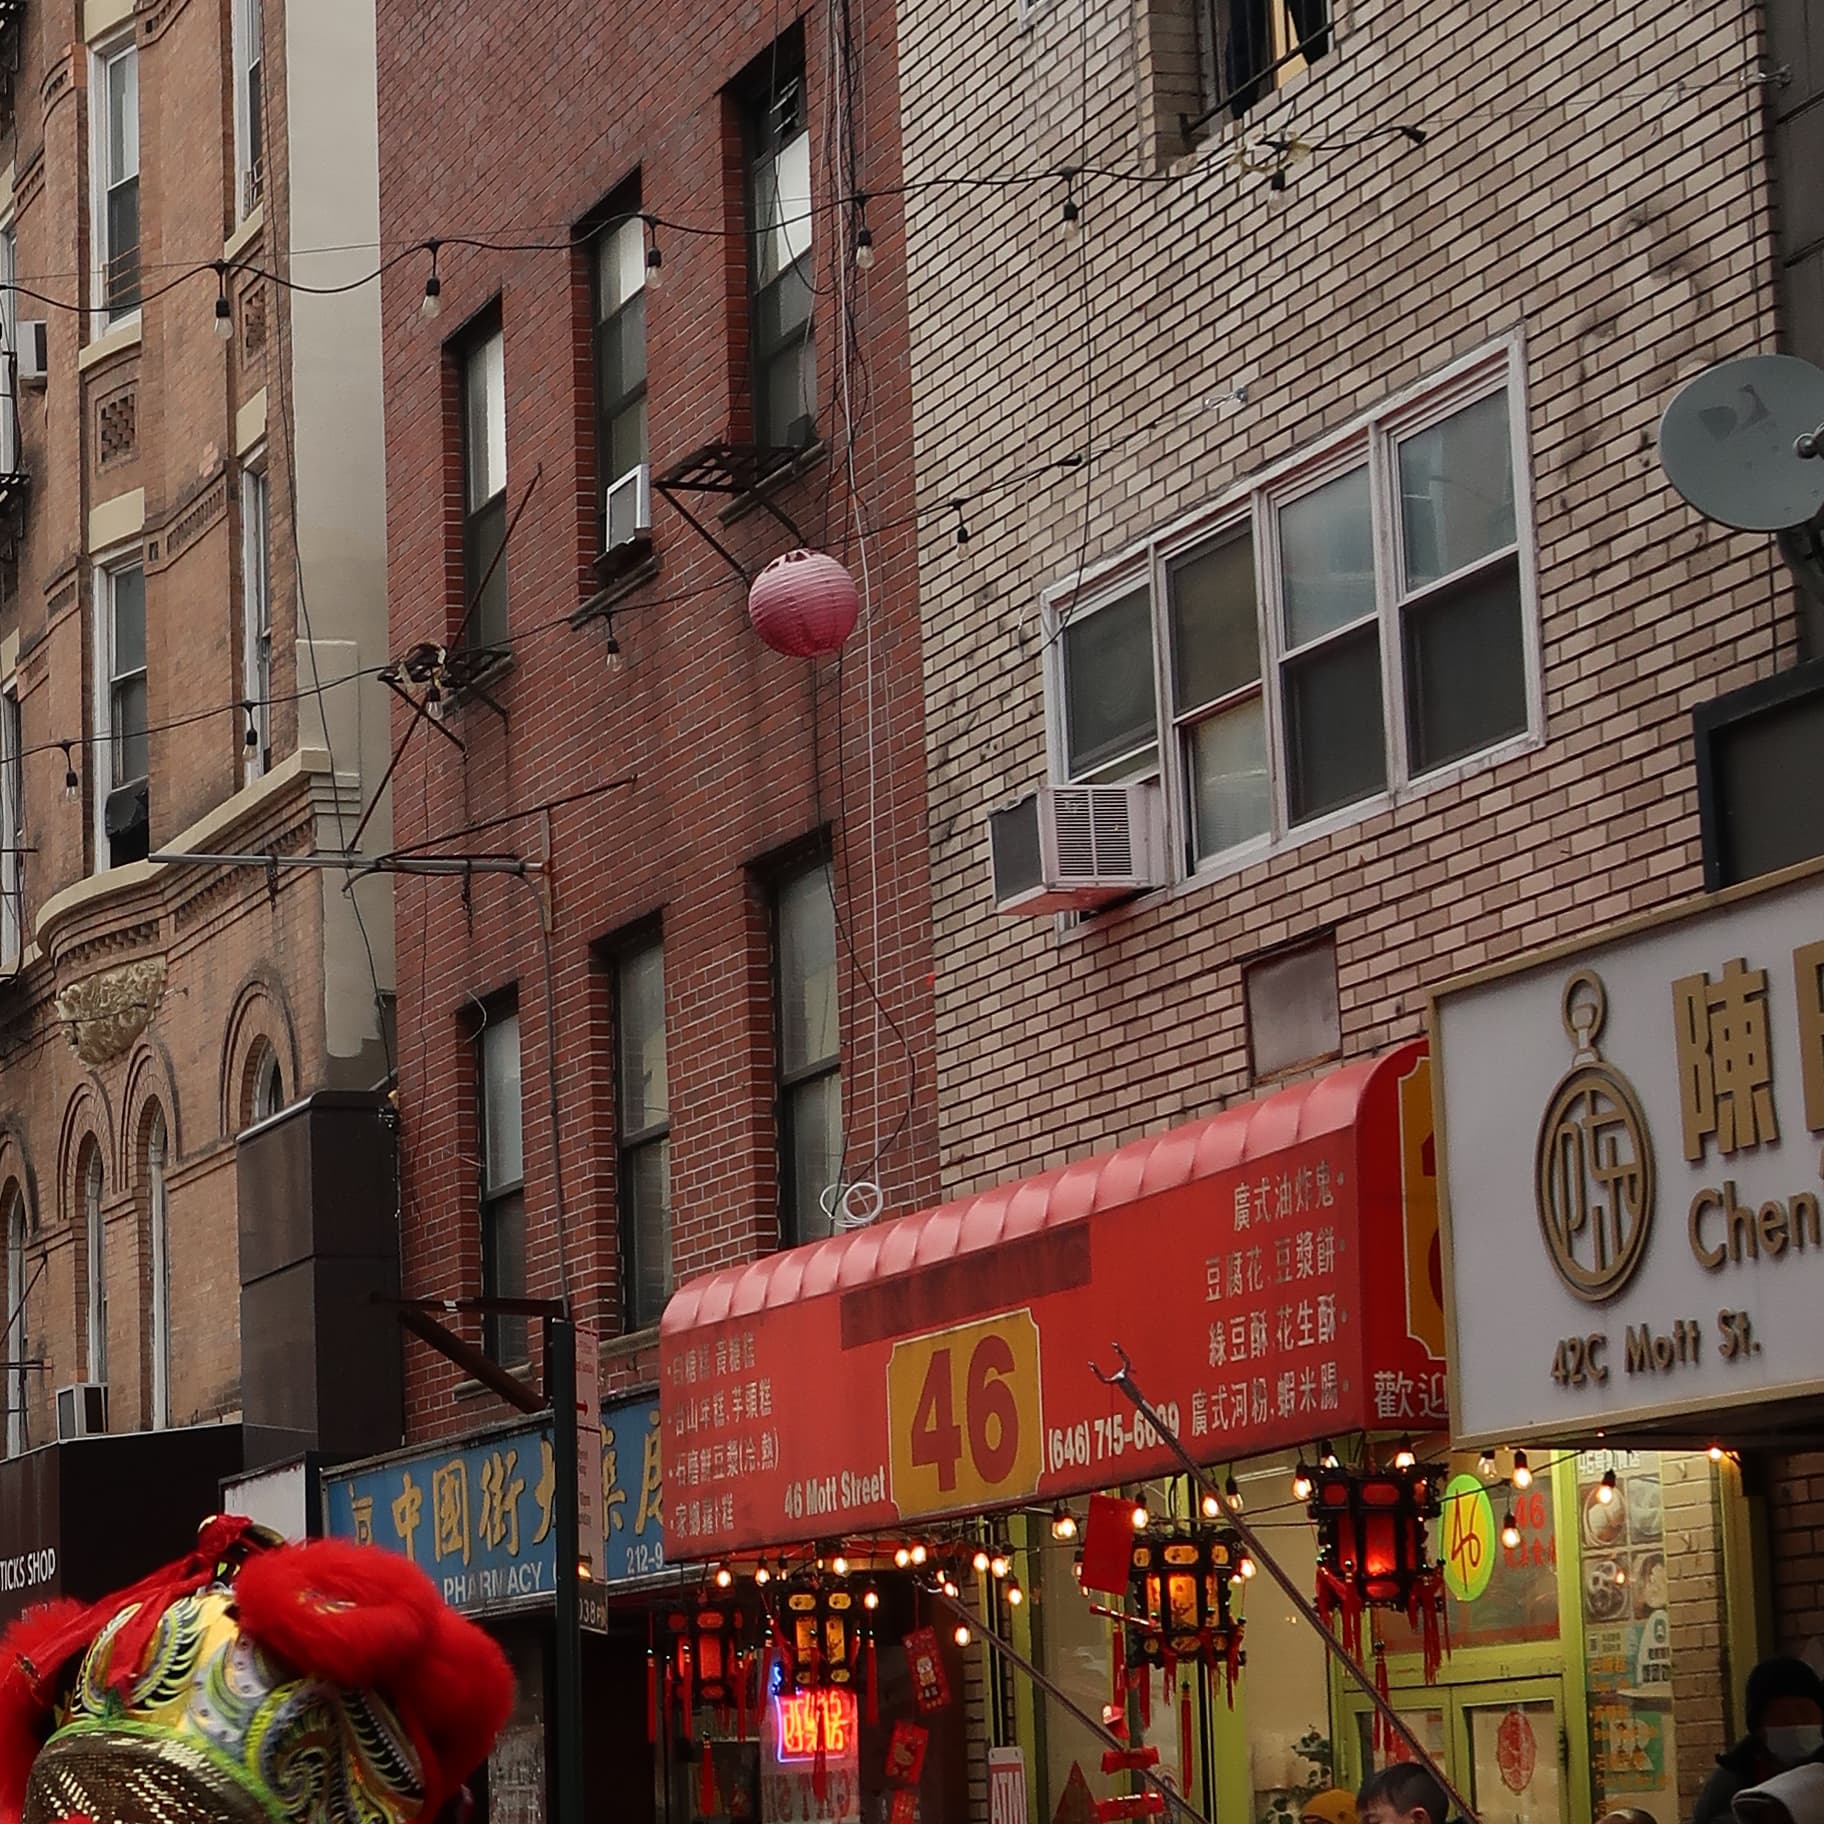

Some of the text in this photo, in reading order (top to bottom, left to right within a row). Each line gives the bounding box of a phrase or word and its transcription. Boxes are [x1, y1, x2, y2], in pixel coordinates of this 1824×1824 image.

[1551, 1308, 1761, 1384] 42C Mott St.
[911, 1335, 1019, 1492] 46
[1049, 1420, 1090, 1473] (646)
[784, 1465, 885, 1519] 46 Mott Street
[27, 1548, 56, 1586] SHOP
[444, 1561, 543, 1604] PHARMACY
